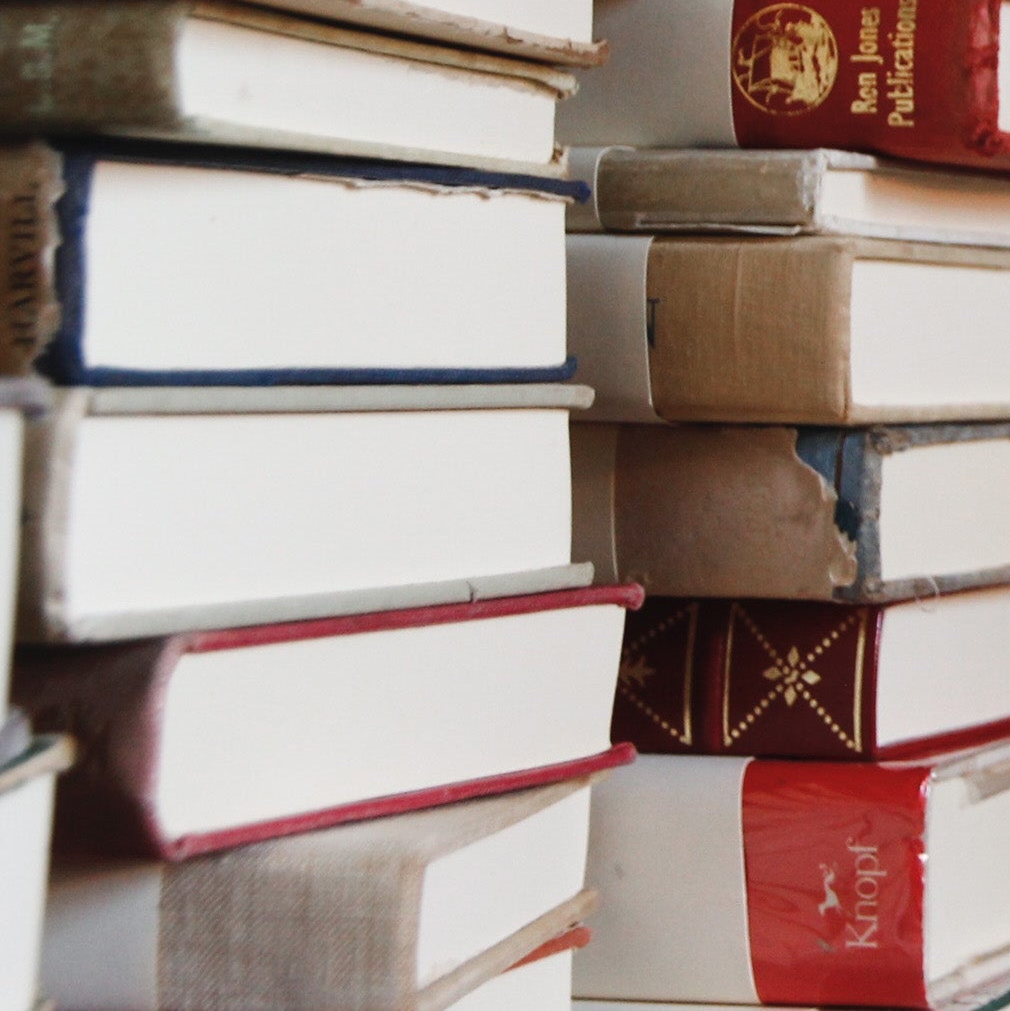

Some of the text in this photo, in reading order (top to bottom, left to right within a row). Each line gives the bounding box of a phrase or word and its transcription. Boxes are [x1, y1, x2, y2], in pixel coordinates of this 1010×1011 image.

[849, 6, 884, 114] Ron Jones
[845, 835, 888, 949] Knopf
